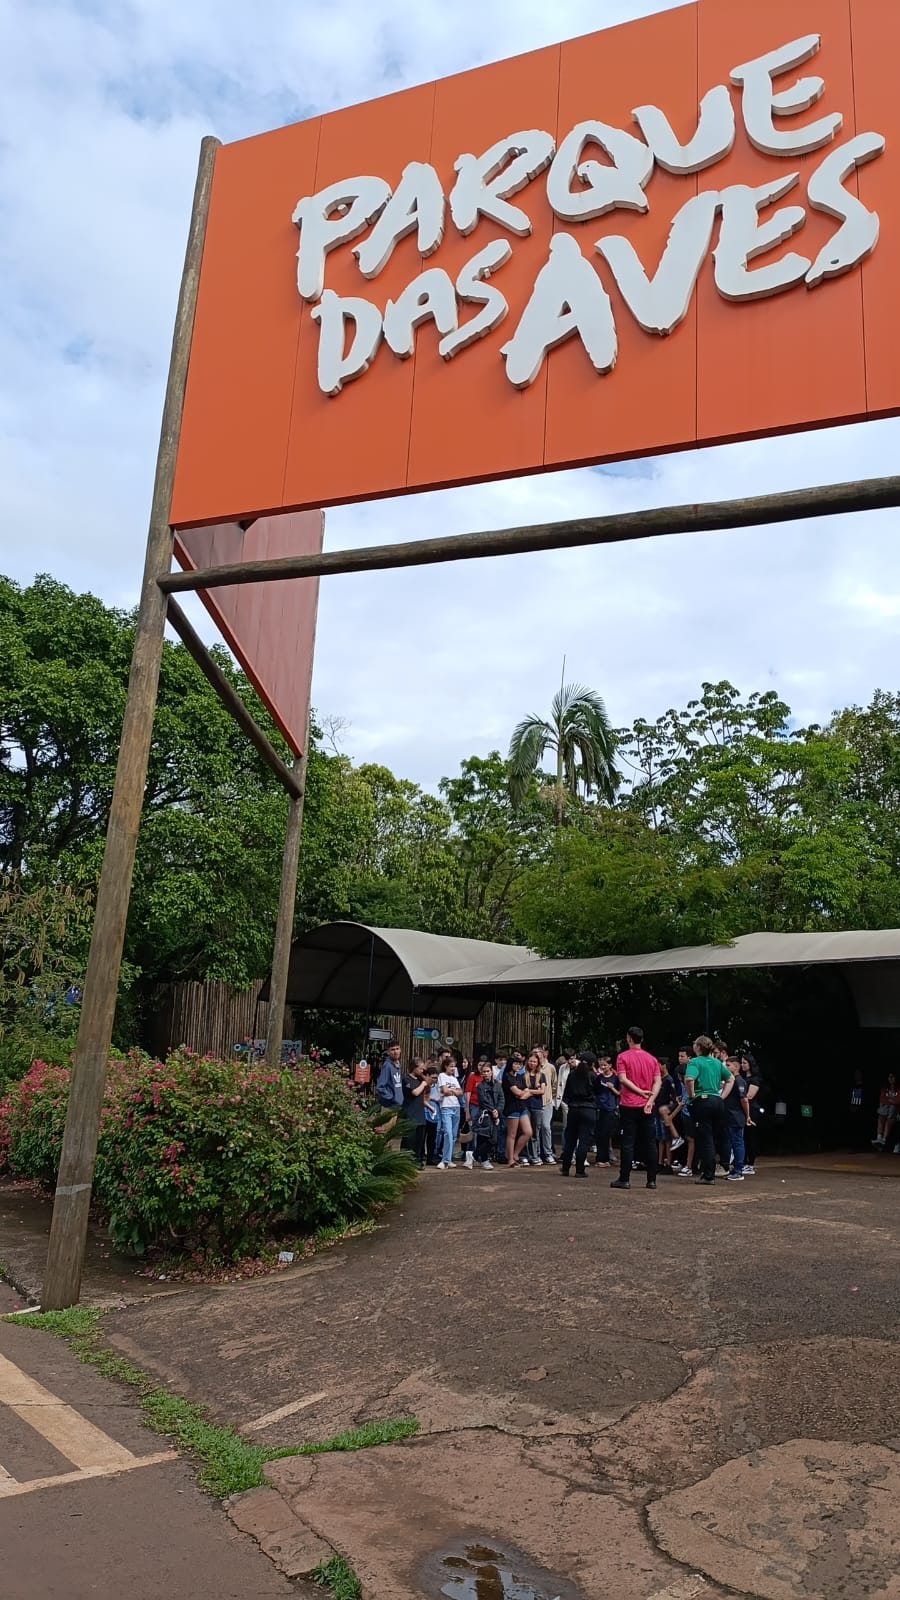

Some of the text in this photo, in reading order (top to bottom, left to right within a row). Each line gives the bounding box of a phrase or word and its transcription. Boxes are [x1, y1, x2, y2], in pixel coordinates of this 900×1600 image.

[292, 33, 843, 301] PARQUE
[311, 131, 885, 396] DAS AVES
